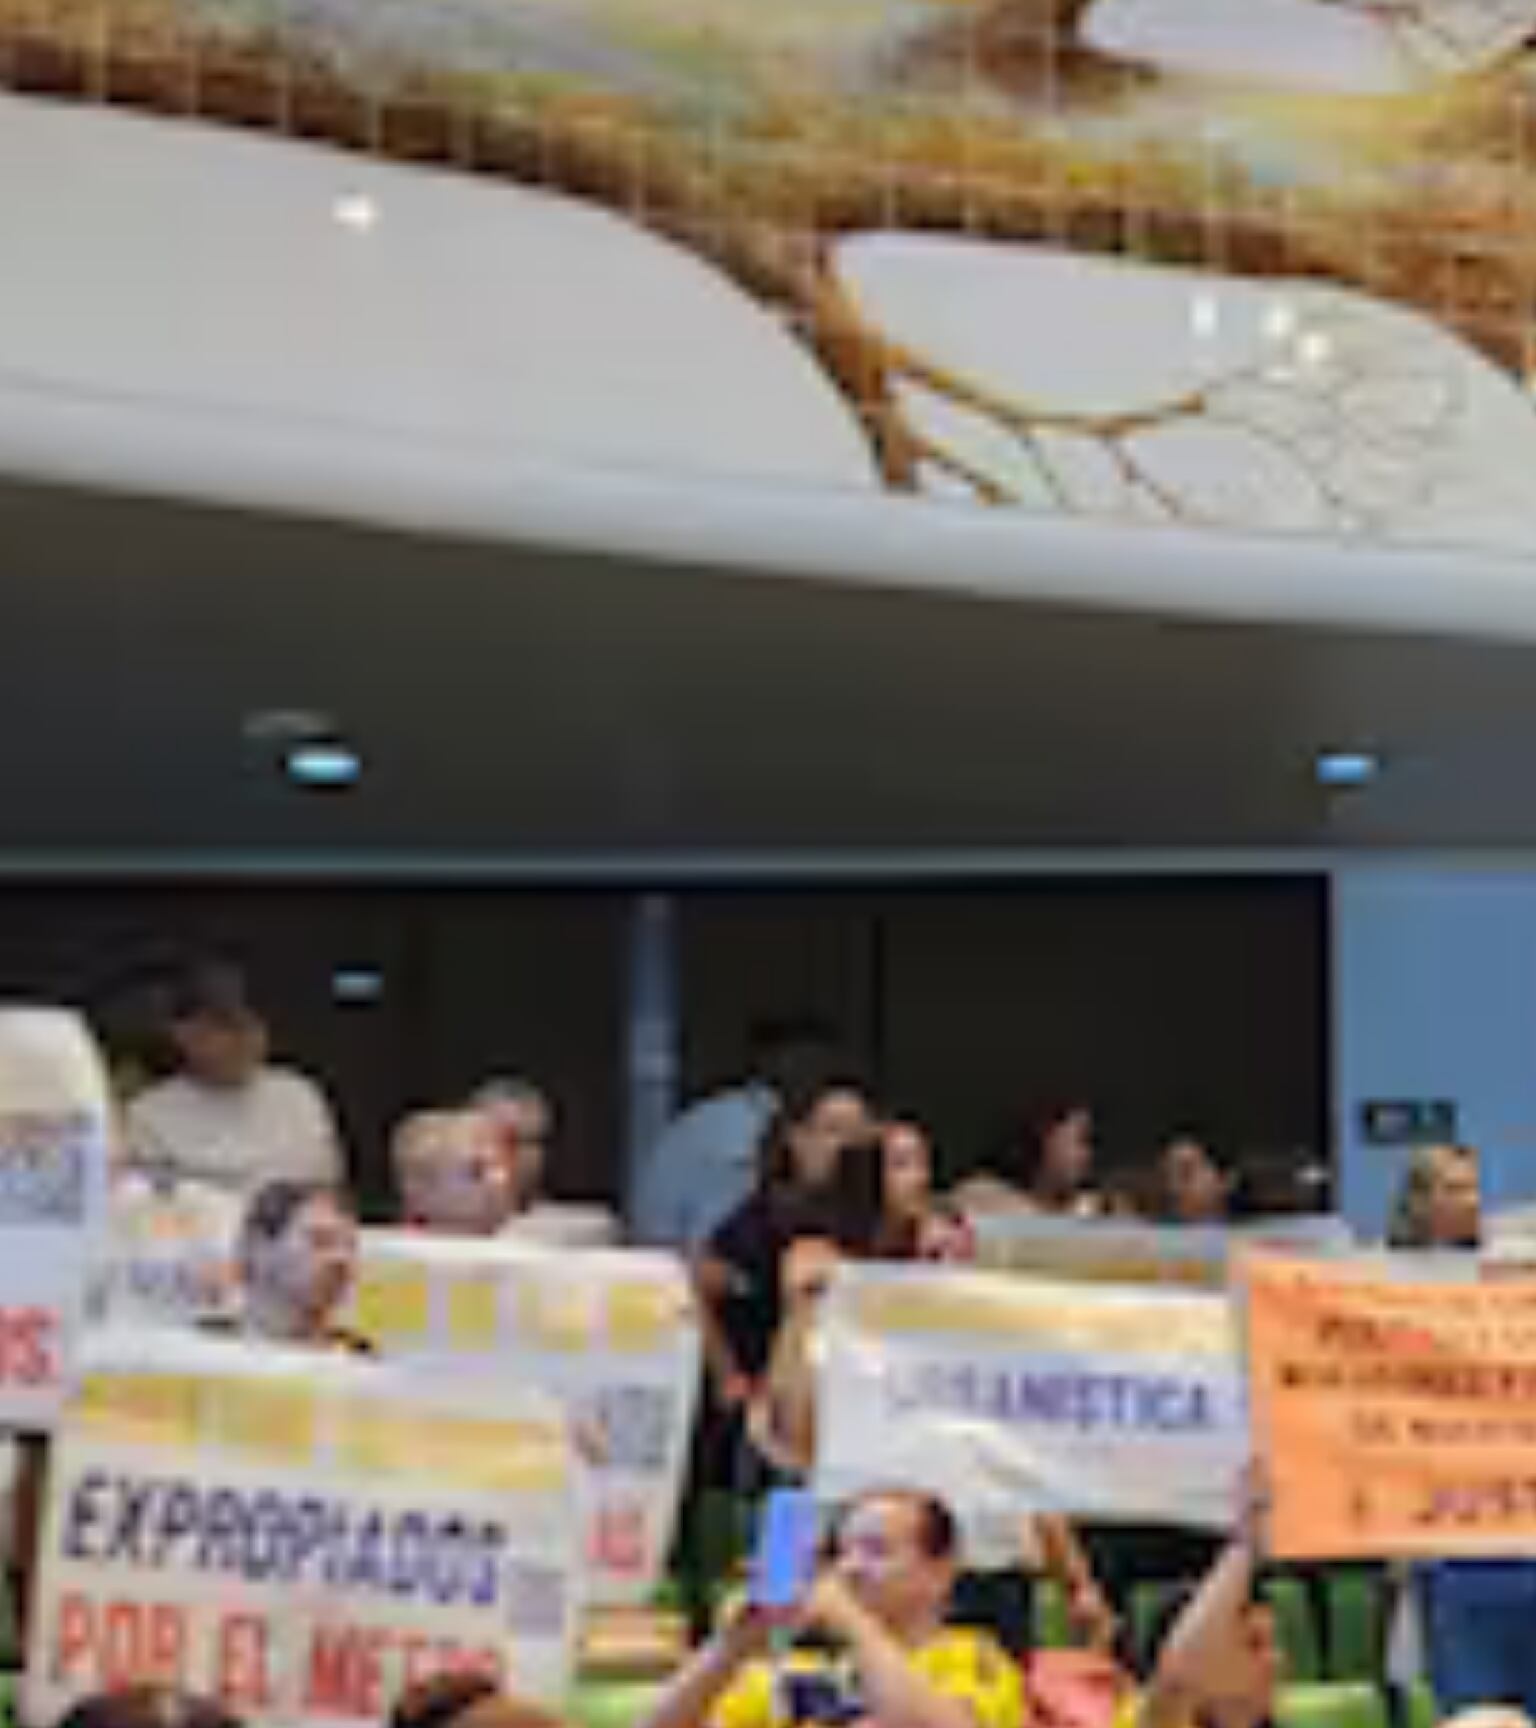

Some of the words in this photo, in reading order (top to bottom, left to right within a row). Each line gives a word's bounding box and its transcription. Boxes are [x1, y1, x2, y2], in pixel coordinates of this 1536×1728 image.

[62, 1466, 506, 1606] EXPROPIADOS
[56, 1594, 186, 1698] POR
[220, 1608, 272, 1710] EL
